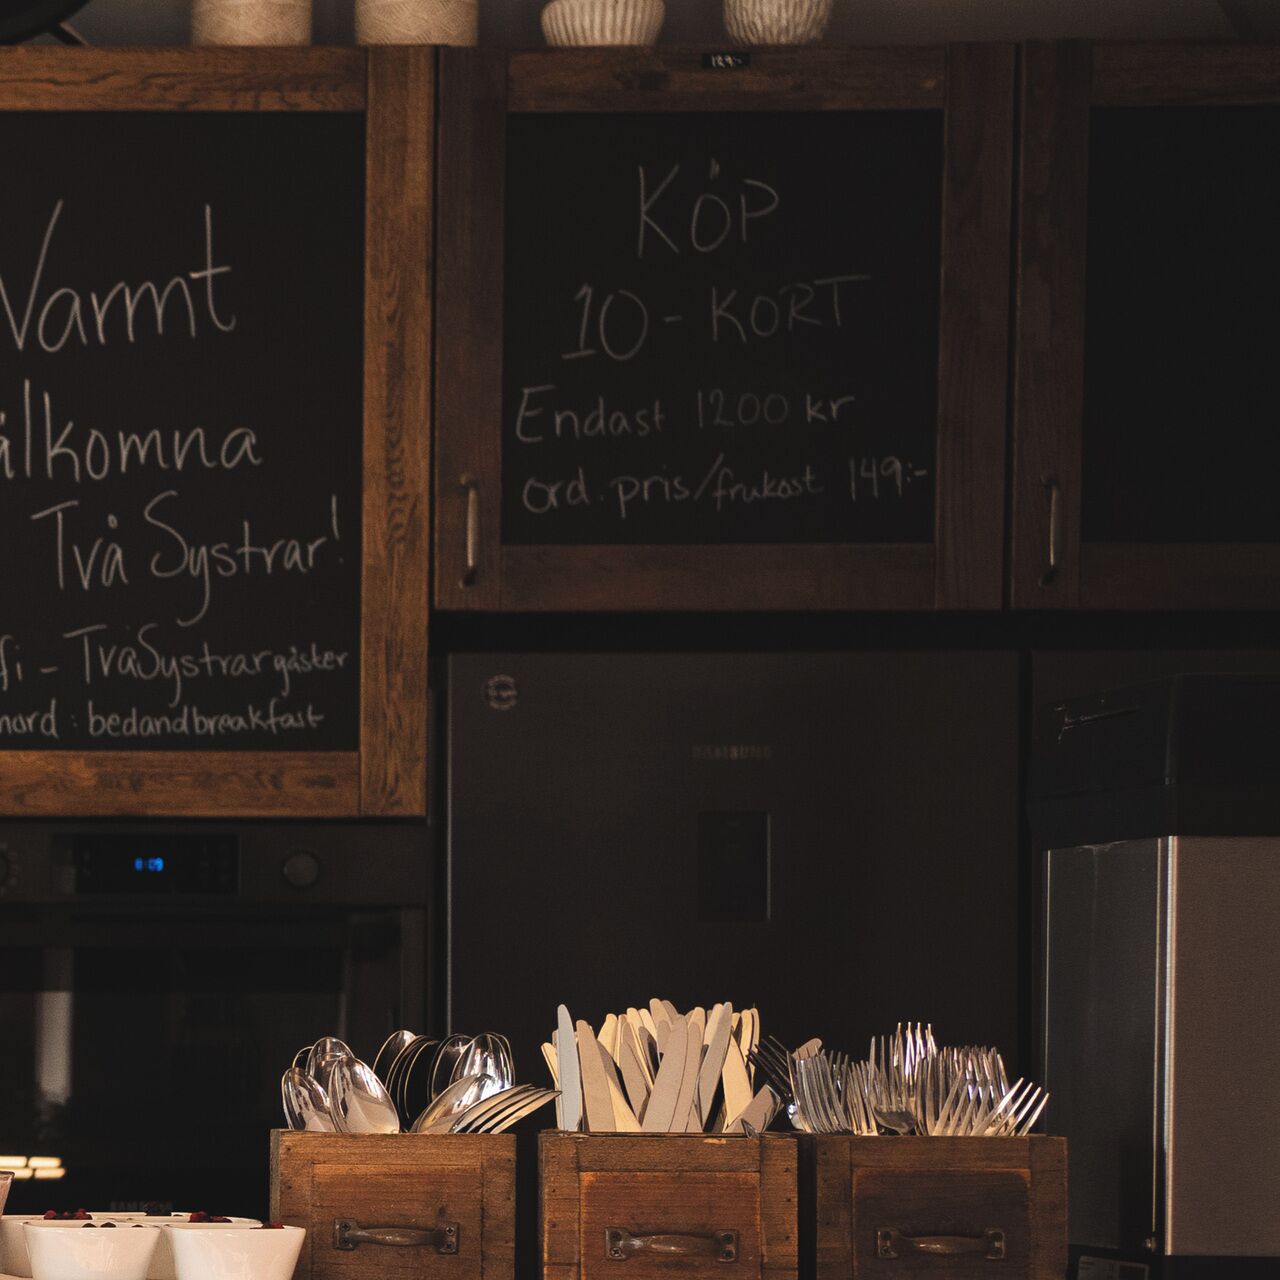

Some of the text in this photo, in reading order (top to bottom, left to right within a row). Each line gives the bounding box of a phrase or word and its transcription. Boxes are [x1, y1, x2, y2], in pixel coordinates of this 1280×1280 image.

[639, 158, 779, 258] KÖP
[516, 385, 855, 443] Endast 1200 kr
[31, 500, 128, 590] Två
[144, 490, 344, 627] Systrar!
[88, 697, 325, 740] bedandbreakfast
